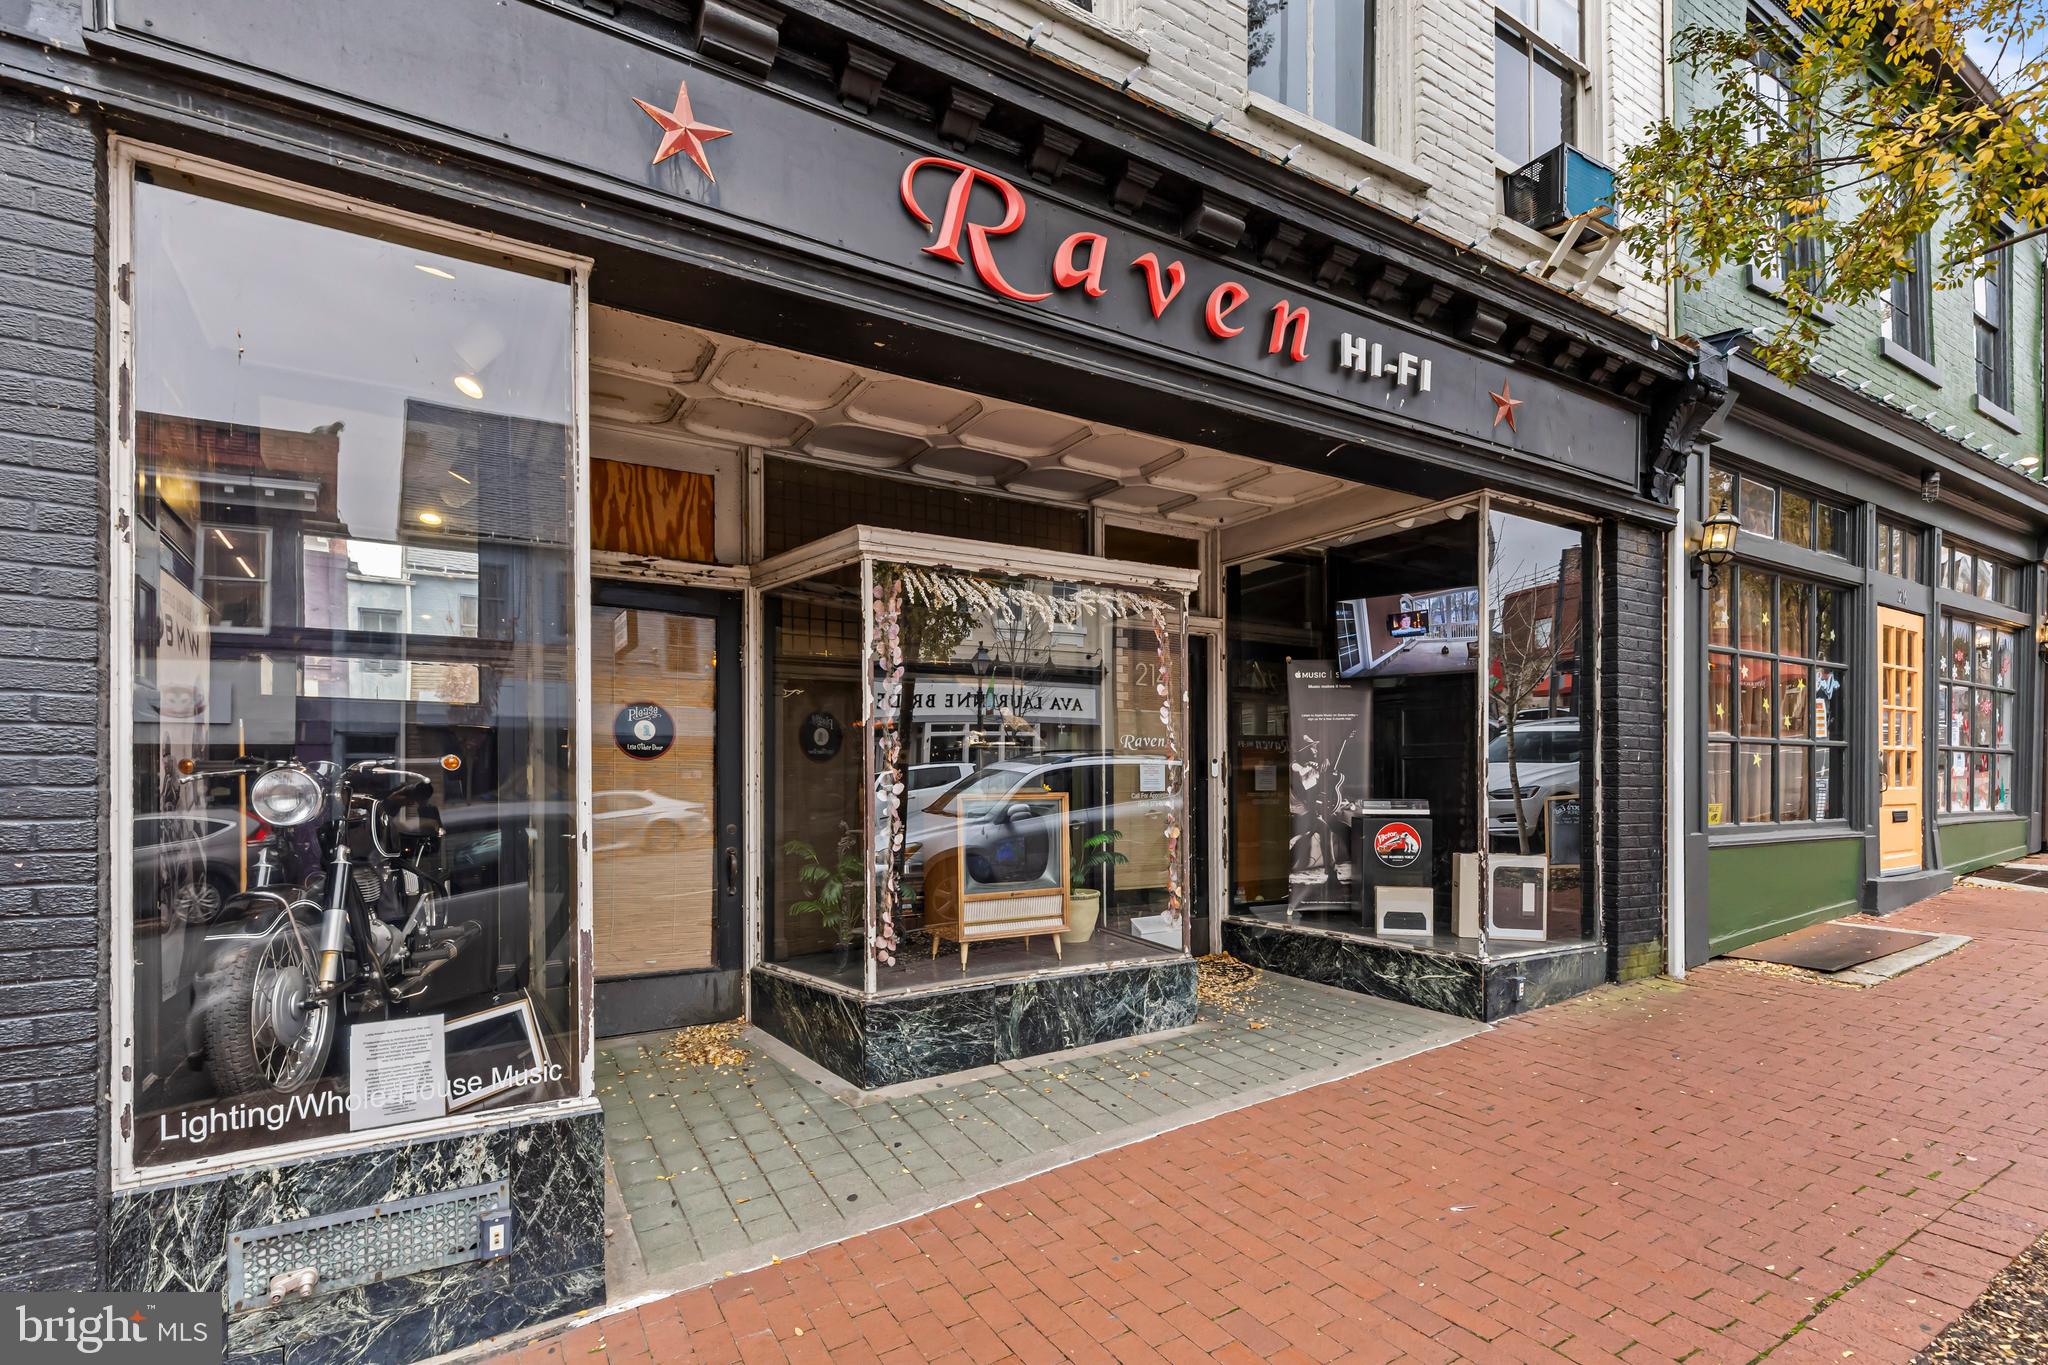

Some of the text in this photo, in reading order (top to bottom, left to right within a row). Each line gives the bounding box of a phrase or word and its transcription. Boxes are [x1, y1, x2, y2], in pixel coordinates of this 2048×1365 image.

[900, 157, 1433, 393] Raven HI-FI
[1302, 671, 1327, 679] MUSIC
[627, 705, 662, 722] Please
[1120, 734, 1165, 750] Raven
[492, 1061, 563, 1090] Music
